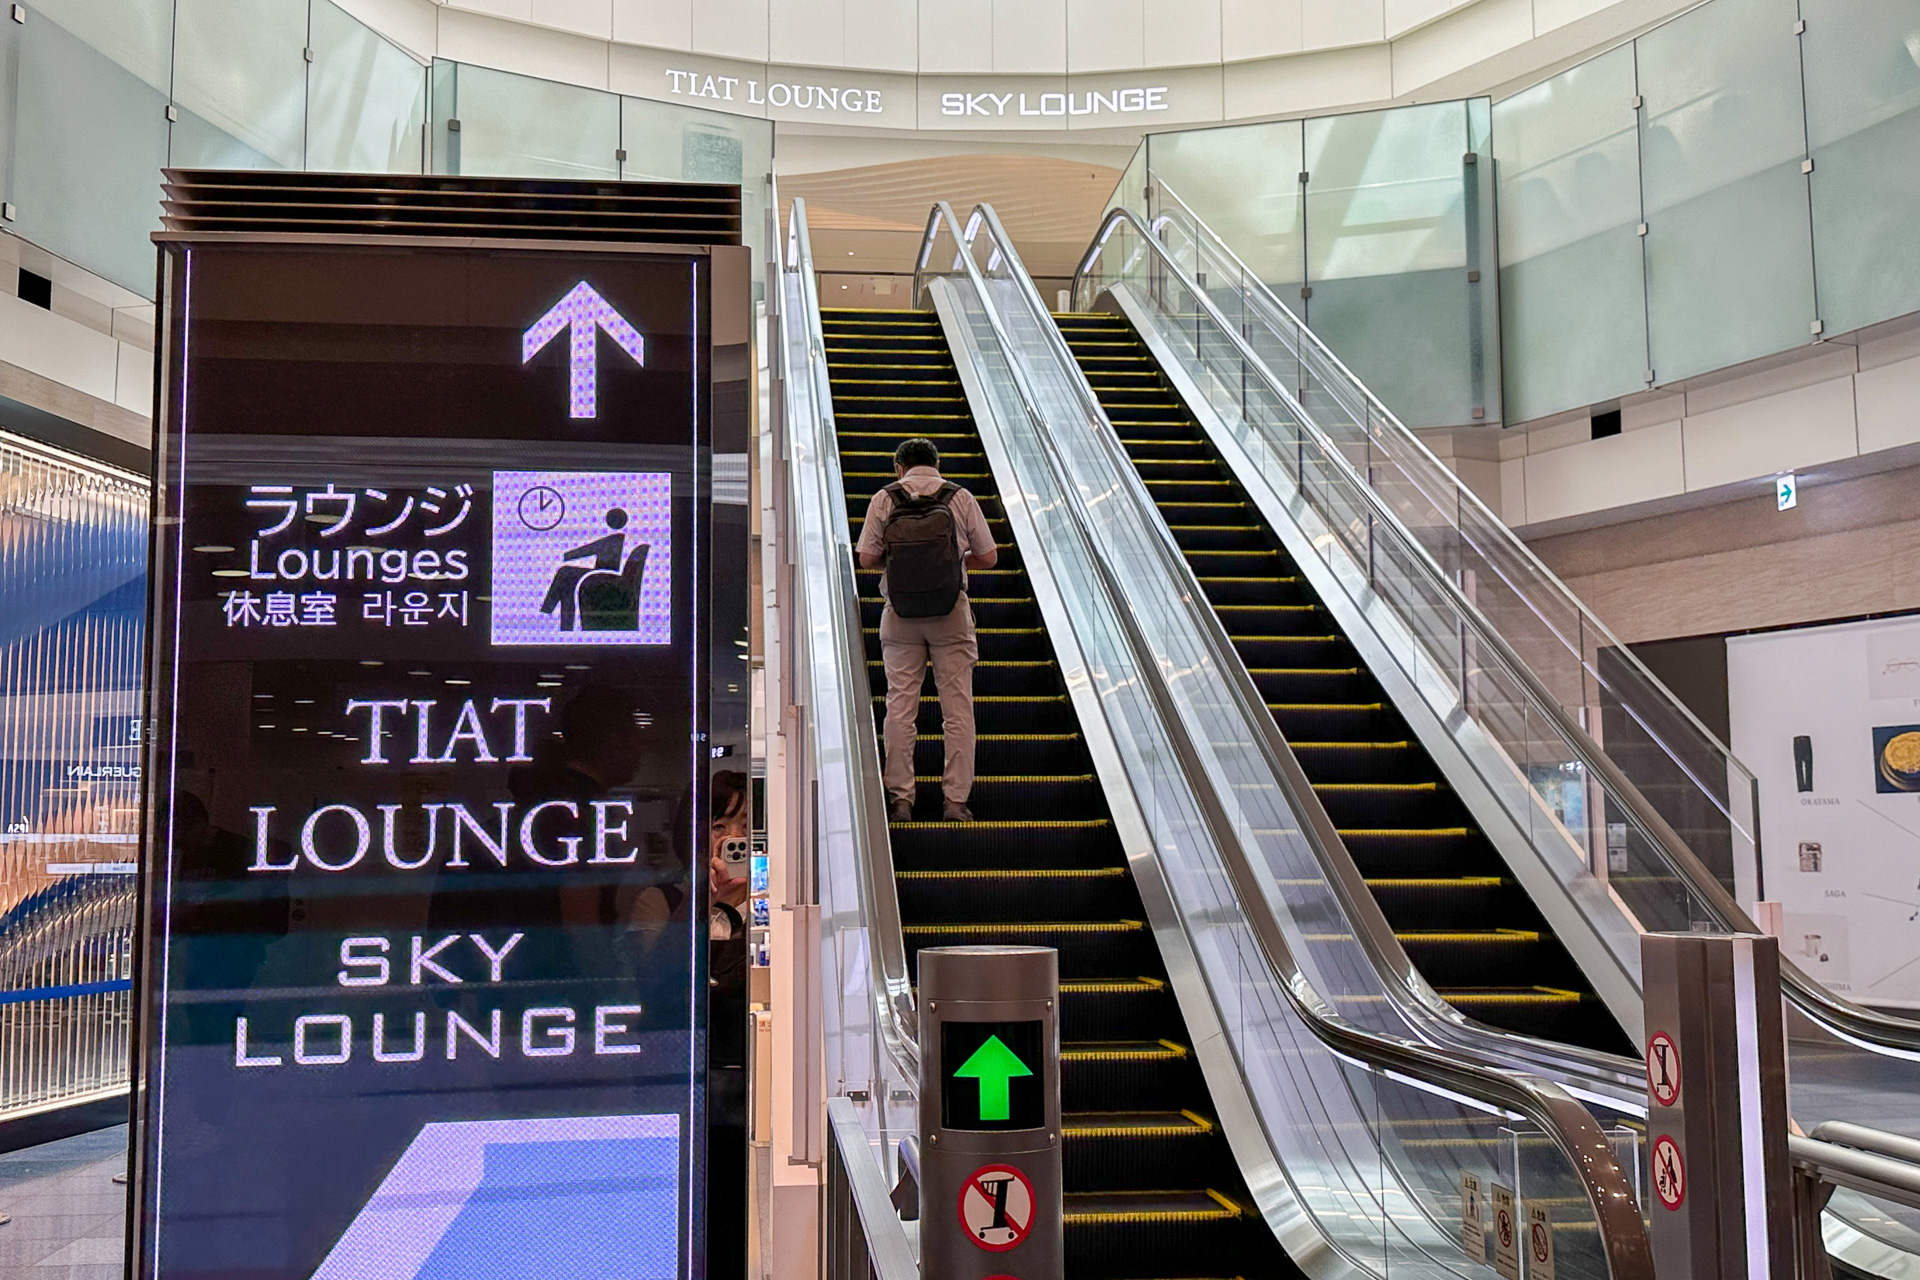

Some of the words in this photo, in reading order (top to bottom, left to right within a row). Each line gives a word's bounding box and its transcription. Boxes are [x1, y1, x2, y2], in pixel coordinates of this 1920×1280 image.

[665, 69, 739, 101] TIAT
[747, 81, 883, 113] LOUNGE
[941, 92, 1013, 117] SKY
[1018, 86, 1169, 116] LOUNGE
[245, 483, 473, 537] ラウンジ
[248, 539, 470, 583] Lounges
[222, 590, 338, 628] 休息室
[362, 590, 470, 627] 라운지
[345, 697, 552, 764] TIAT
[1801, 797, 1840, 806] OKAYAMA
[247, 800, 639, 872] LOUNGE
[1824, 889, 1847, 898] SAGA
[337, 932, 525, 988] SKY
[235, 1004, 643, 1068] LOUNGE
